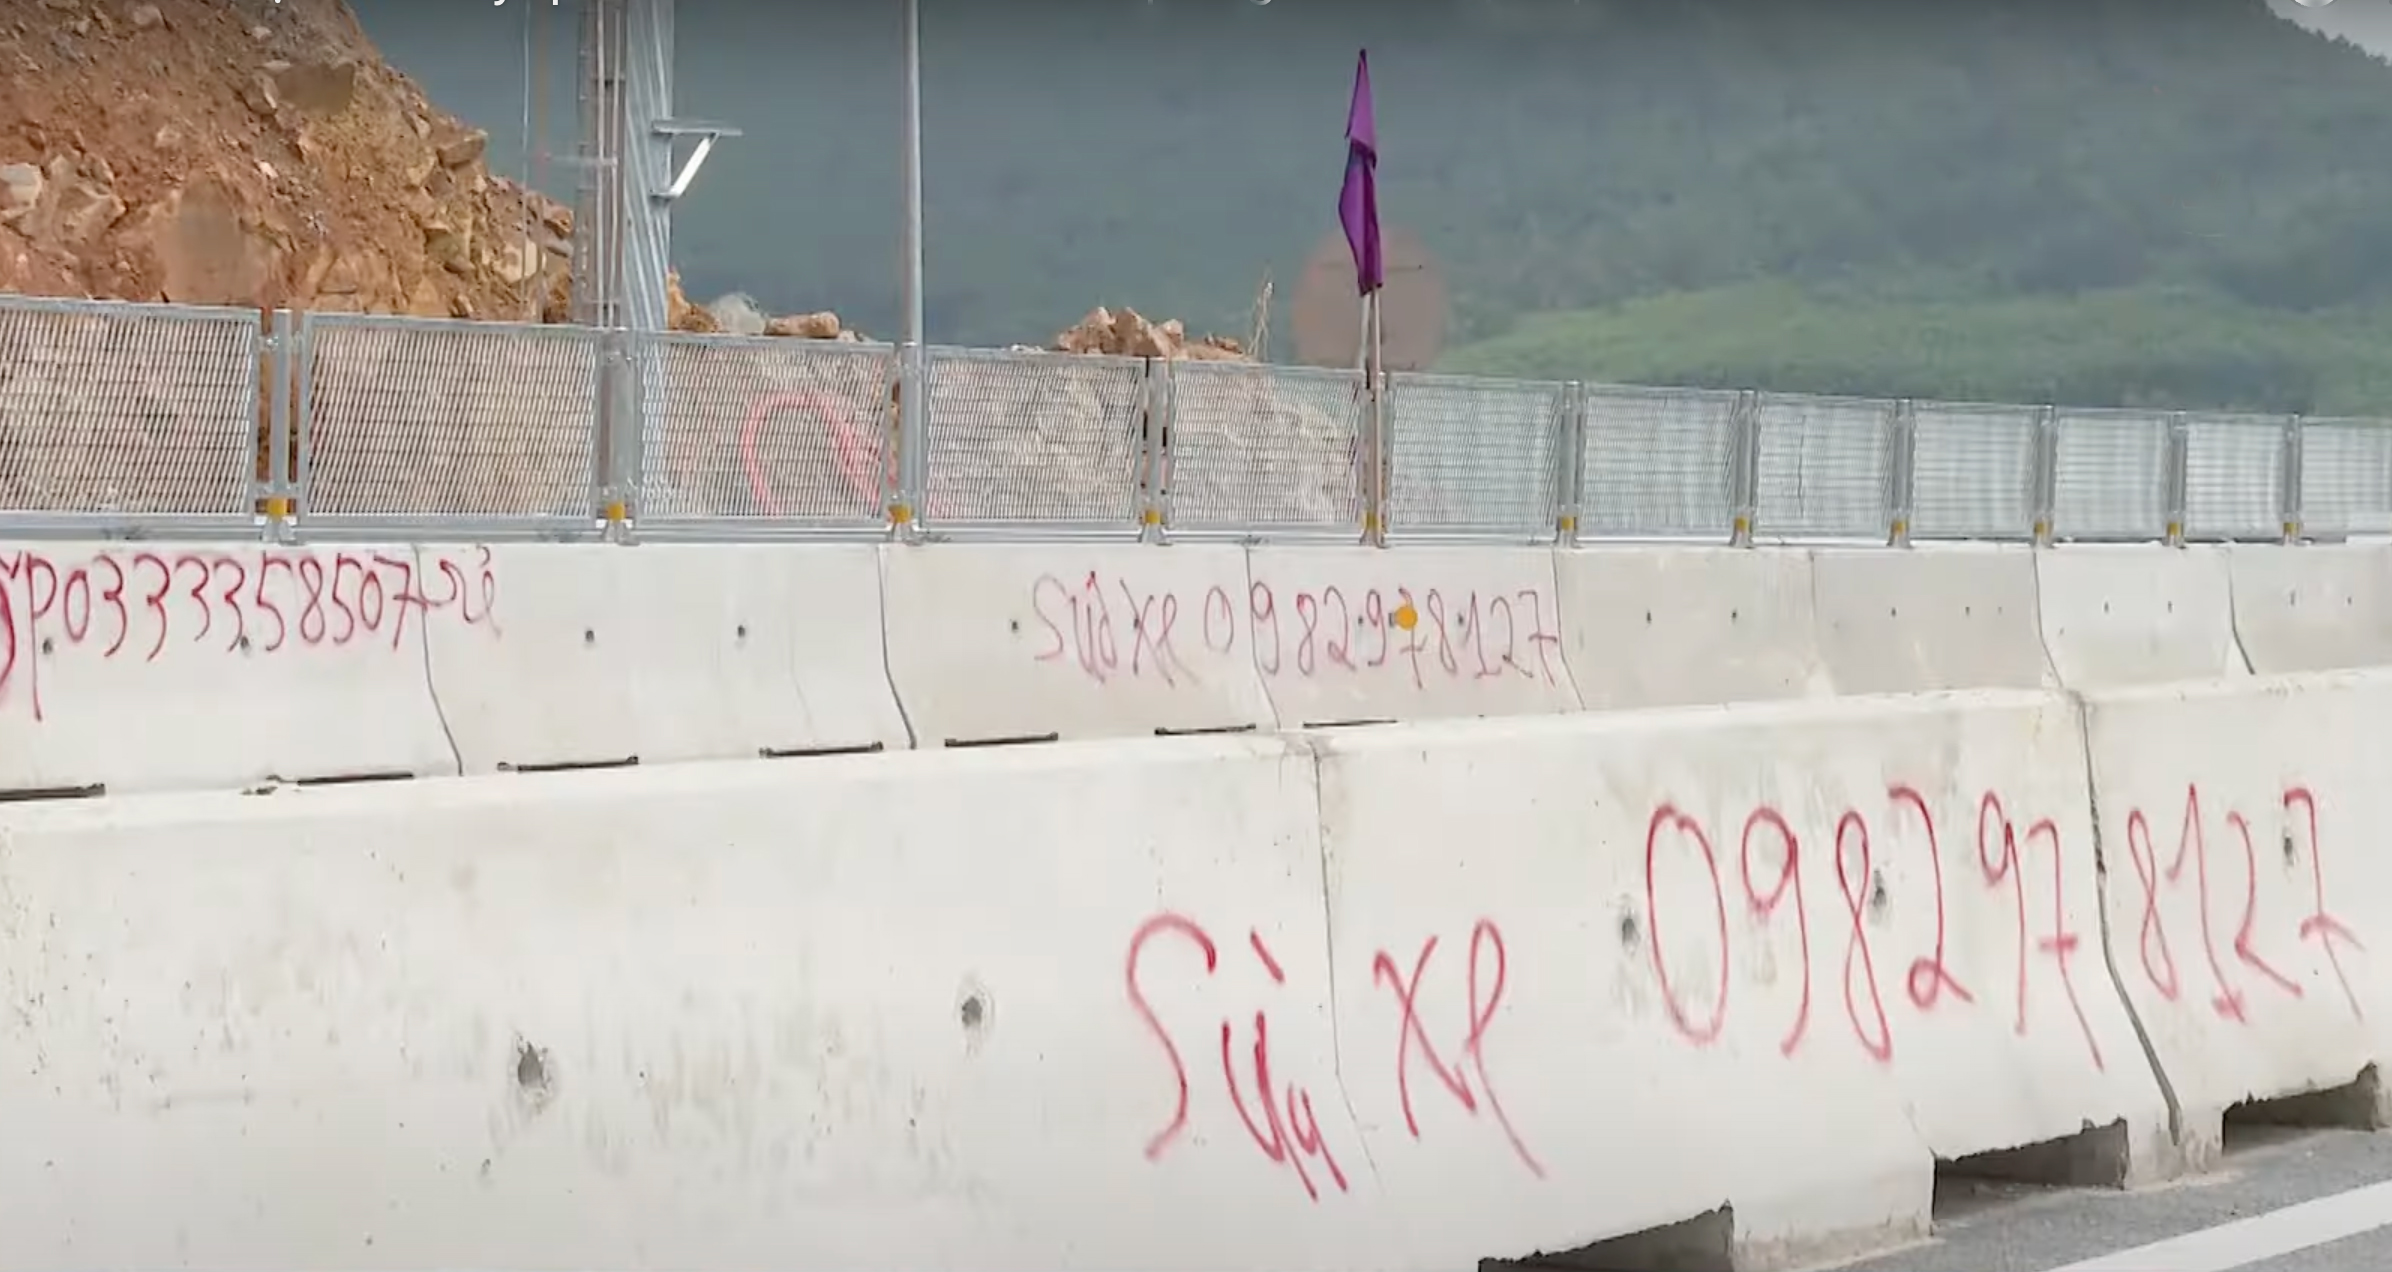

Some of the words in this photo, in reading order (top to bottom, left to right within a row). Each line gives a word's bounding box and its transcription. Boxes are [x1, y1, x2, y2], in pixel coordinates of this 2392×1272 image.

[64, 549, 438, 664] 0333358507
[1203, 580, 1560, 691] 0982978127
[1645, 783, 2366, 1073] 0982978127
